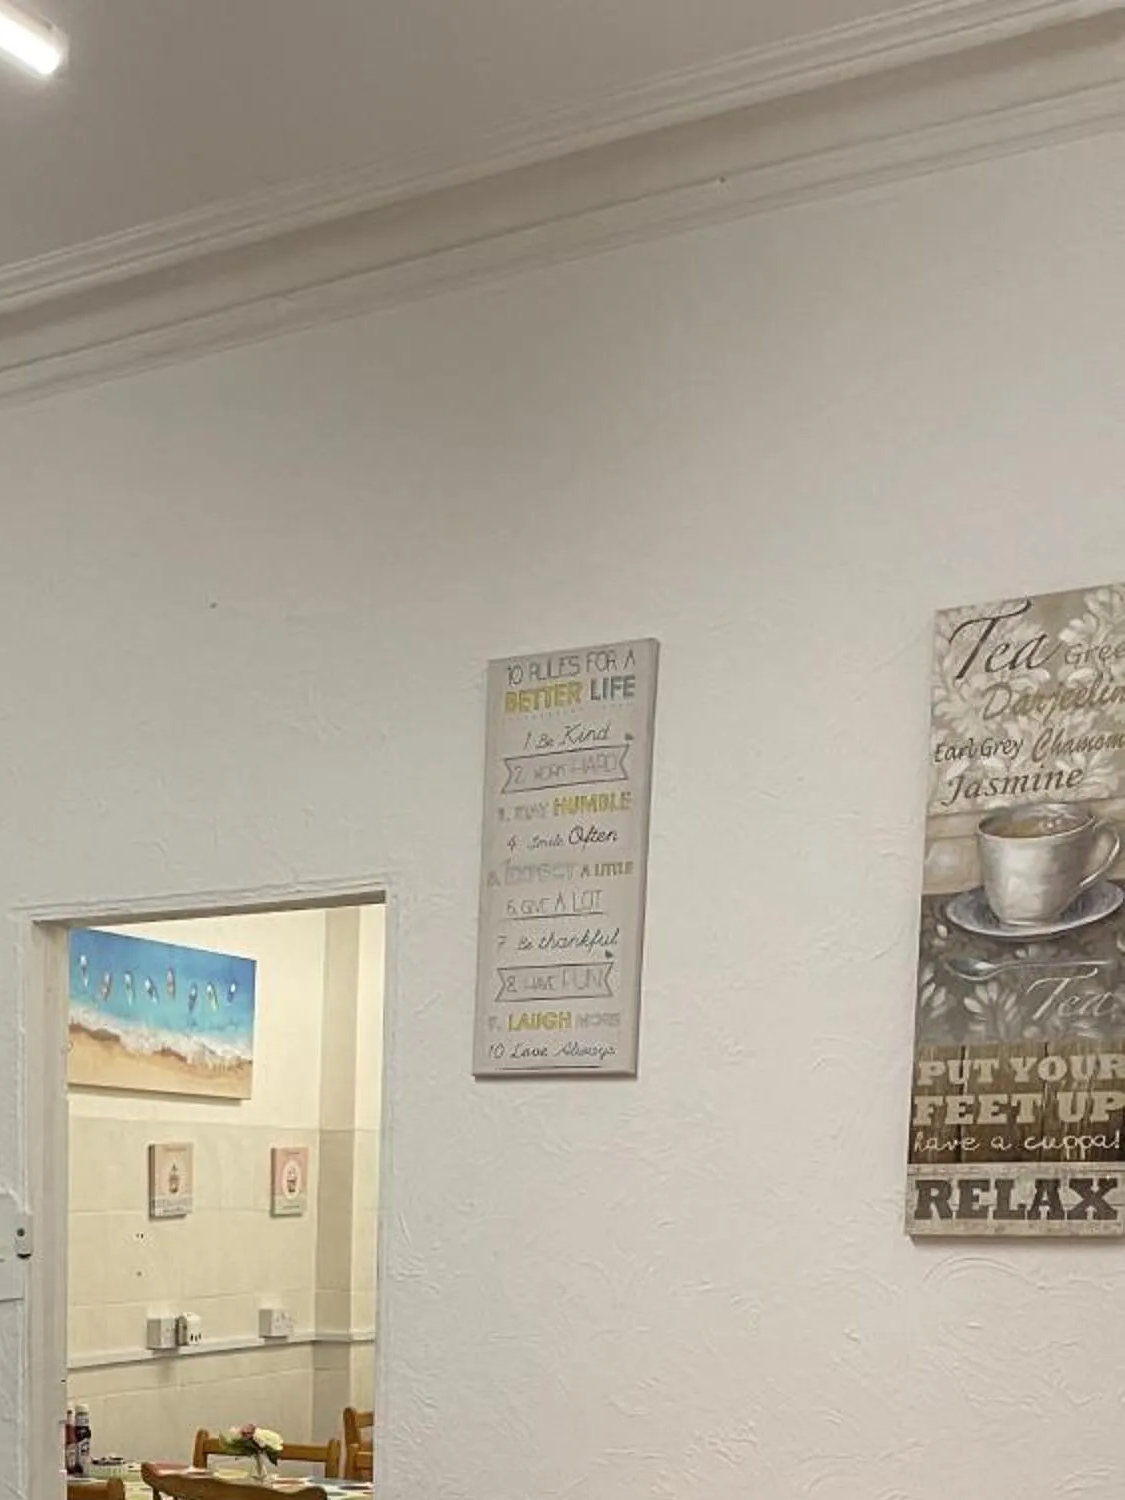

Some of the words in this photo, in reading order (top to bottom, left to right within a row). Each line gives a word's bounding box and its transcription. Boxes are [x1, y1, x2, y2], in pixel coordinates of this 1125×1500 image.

[948, 599, 1062, 680] Tea
[506, 664, 524, 686] 10
[529, 656, 580, 681] RULES
[586, 651, 617, 672] FOR
[623, 650, 636, 669] A
[506, 683, 582, 713] BETTER
[591, 676, 635, 700] LIFE
[560, 722, 611, 745] Kind
[934, 737, 976, 763] Earl
[980, 737, 1024, 761] Grey
[941, 764, 1084, 807] Jasmine
[554, 792, 631, 815] HUMBLE
[569, 825, 618, 849] Often
[554, 891, 567, 913] A
[572, 889, 604, 913] LOT
[537, 927, 620, 953] thankful
[1027, 968, 1114, 1020] Tea
[508, 1012, 571, 1031] LAUGH
[918, 1057, 999, 1085] PUT
[1010, 1055, 1125, 1082] YOUR
[913, 1093, 1043, 1126] FEET
[1056, 1091, 1125, 1123] UP
[914, 1131, 980, 1152] have
[990, 1134, 1013, 1151] a
[1024, 1130, 1122, 1161] cuppa!
[914, 1178, 1118, 1221] RELAX
